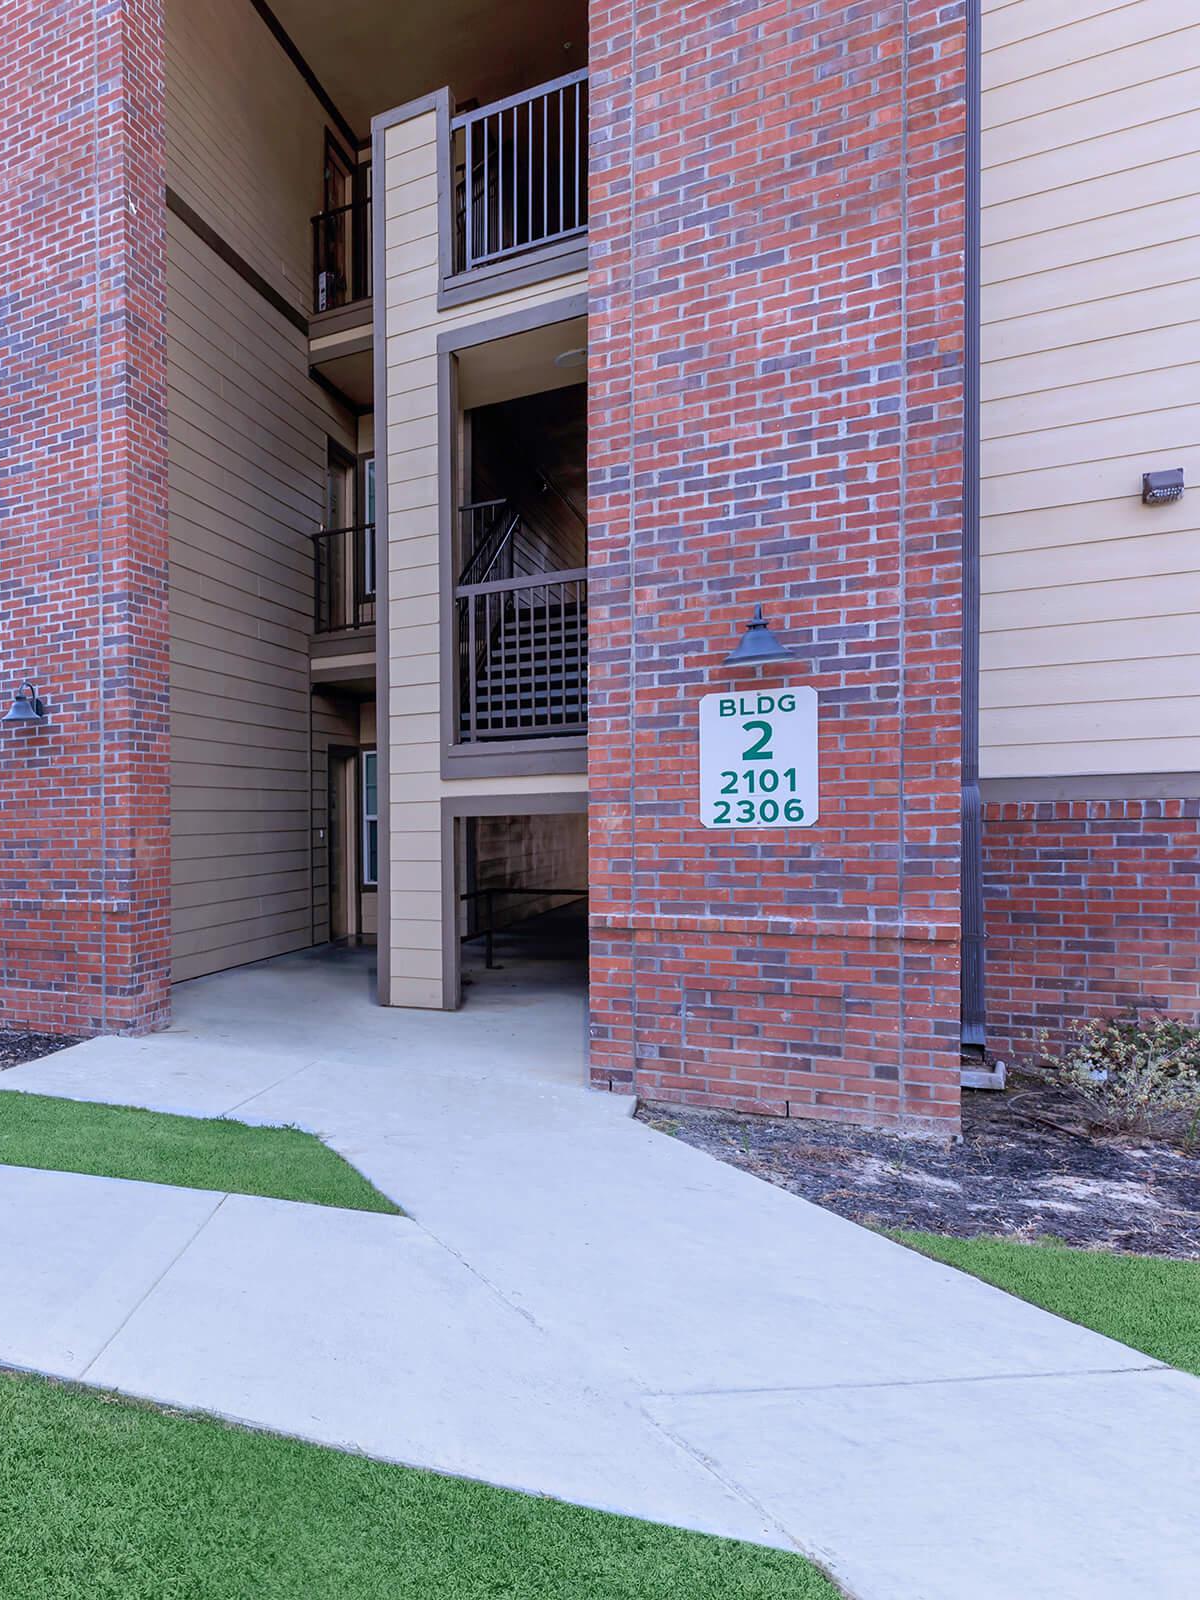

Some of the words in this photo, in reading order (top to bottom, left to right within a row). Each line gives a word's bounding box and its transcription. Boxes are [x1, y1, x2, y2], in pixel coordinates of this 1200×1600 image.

[719, 694, 796, 717] BLDG
[742, 720, 773, 761] 2
[720, 767, 796, 795] 2101
[713, 798, 804, 824] 2306
